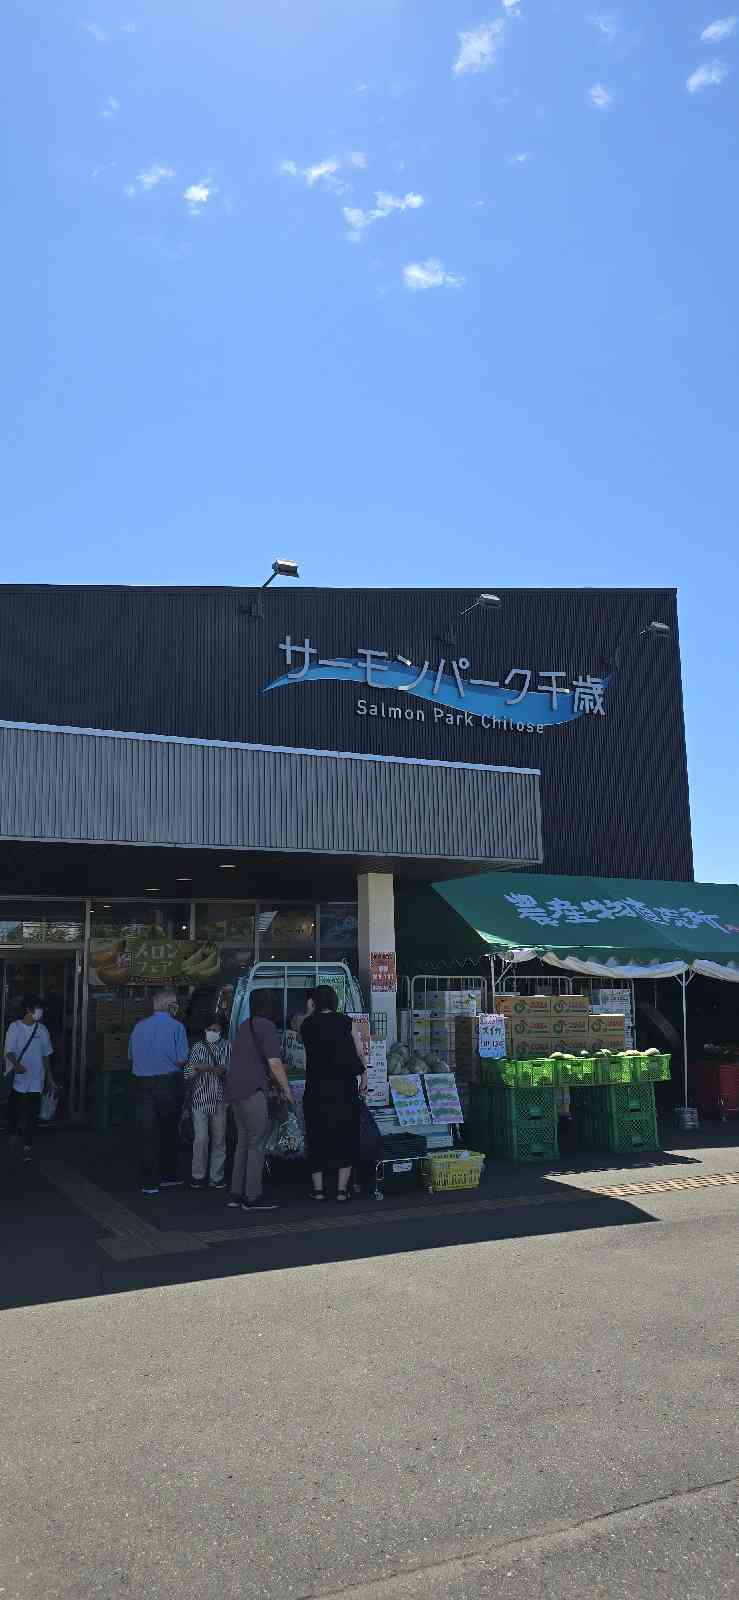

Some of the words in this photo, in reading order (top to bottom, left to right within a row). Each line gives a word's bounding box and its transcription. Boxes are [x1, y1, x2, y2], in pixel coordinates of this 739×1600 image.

[278, 635, 606, 716] サーモンパーク千歳
[356, 699, 425, 722] Salmon
[433, 708, 474, 727] Park
